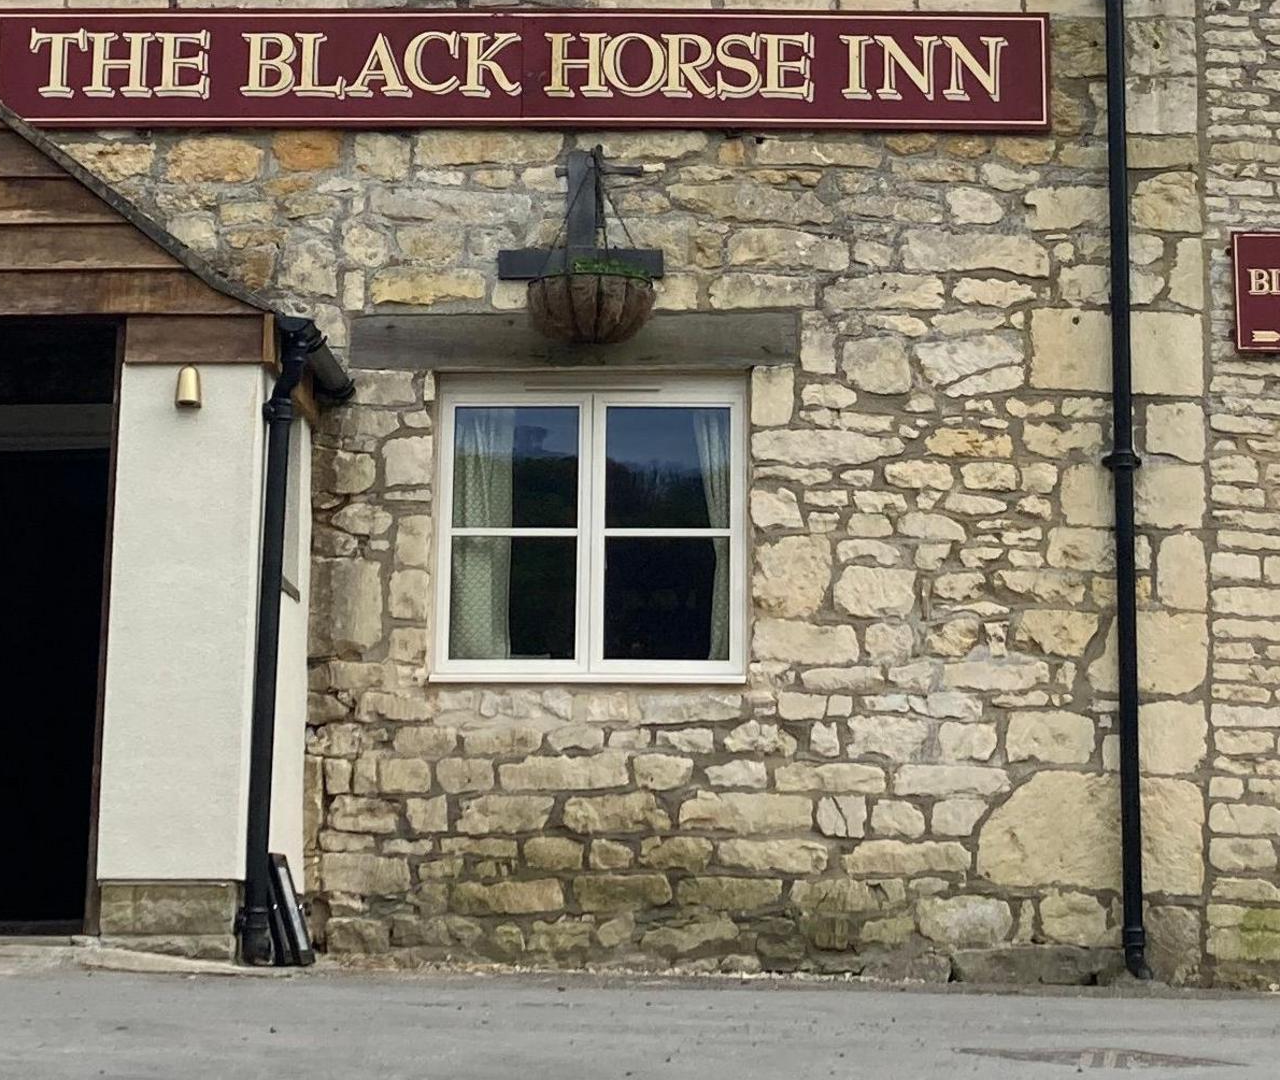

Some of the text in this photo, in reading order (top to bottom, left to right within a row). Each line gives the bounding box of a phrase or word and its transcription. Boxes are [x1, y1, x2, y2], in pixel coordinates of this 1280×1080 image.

[29, 27, 1009, 103] THE BLACK HORSE INN
